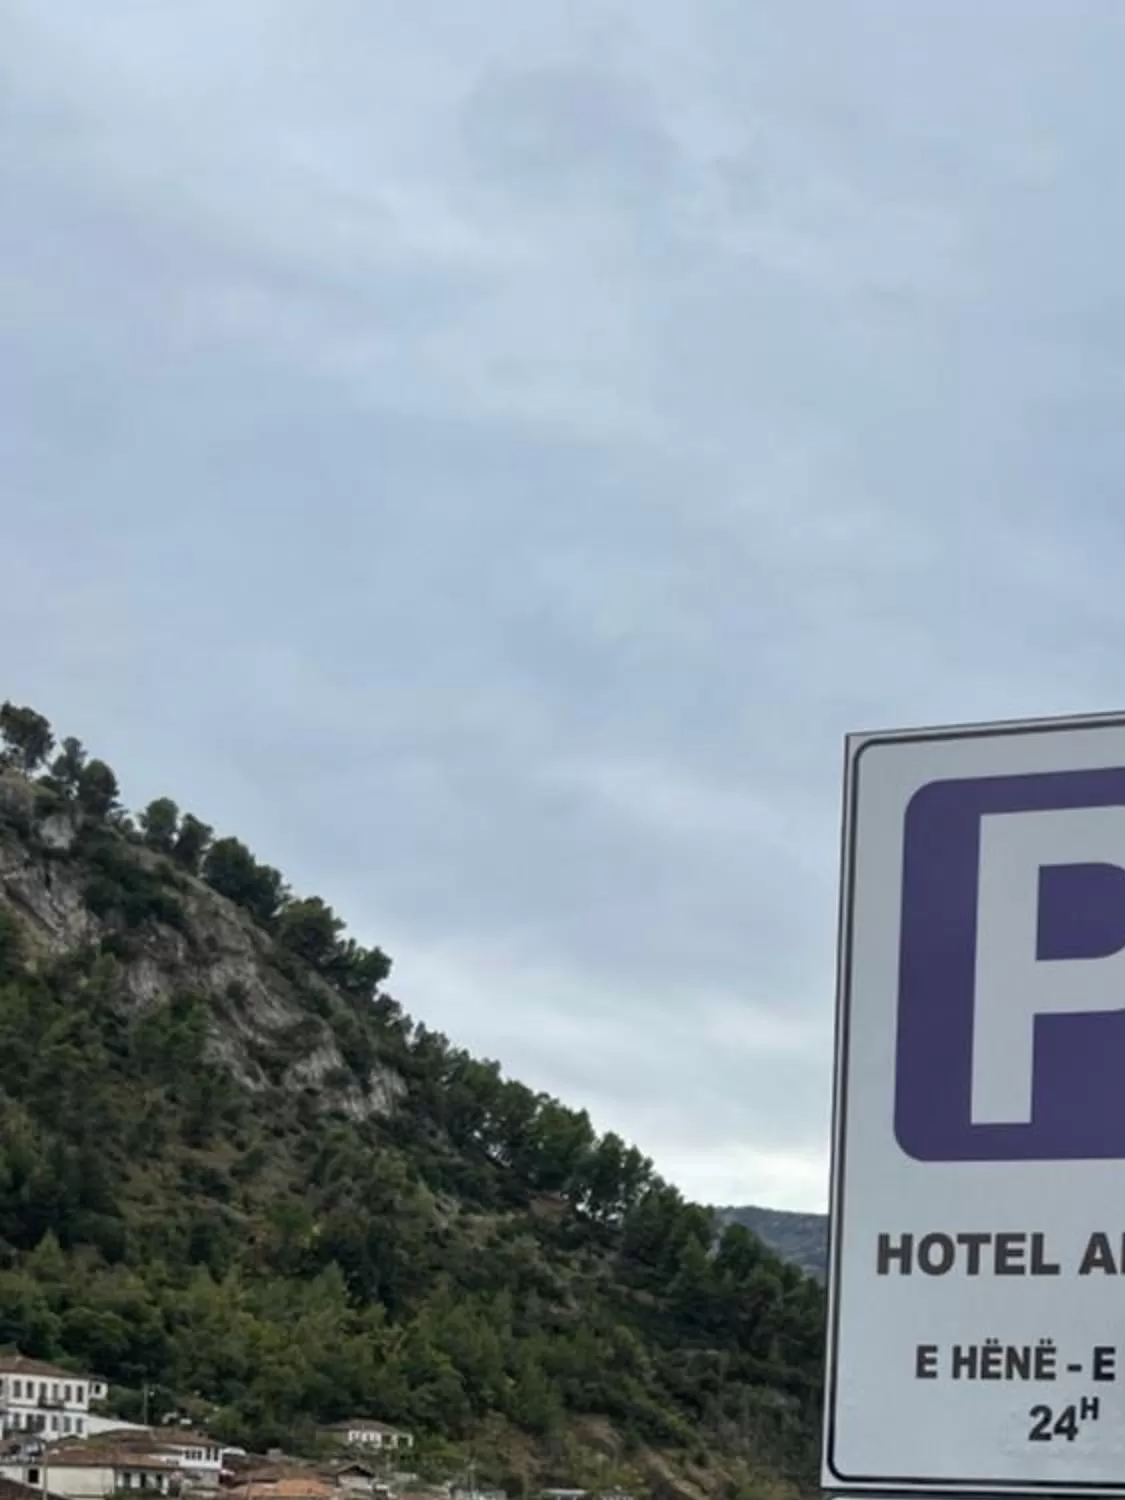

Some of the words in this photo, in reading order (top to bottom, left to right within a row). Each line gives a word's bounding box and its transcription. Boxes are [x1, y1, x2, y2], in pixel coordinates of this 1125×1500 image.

[876, 1232, 1060, 1276] HOTEL
[915, 1344, 938, 1379] E
[952, 1338, 1057, 1380] HËNË
[1092, 1347, 1116, 1381] E
